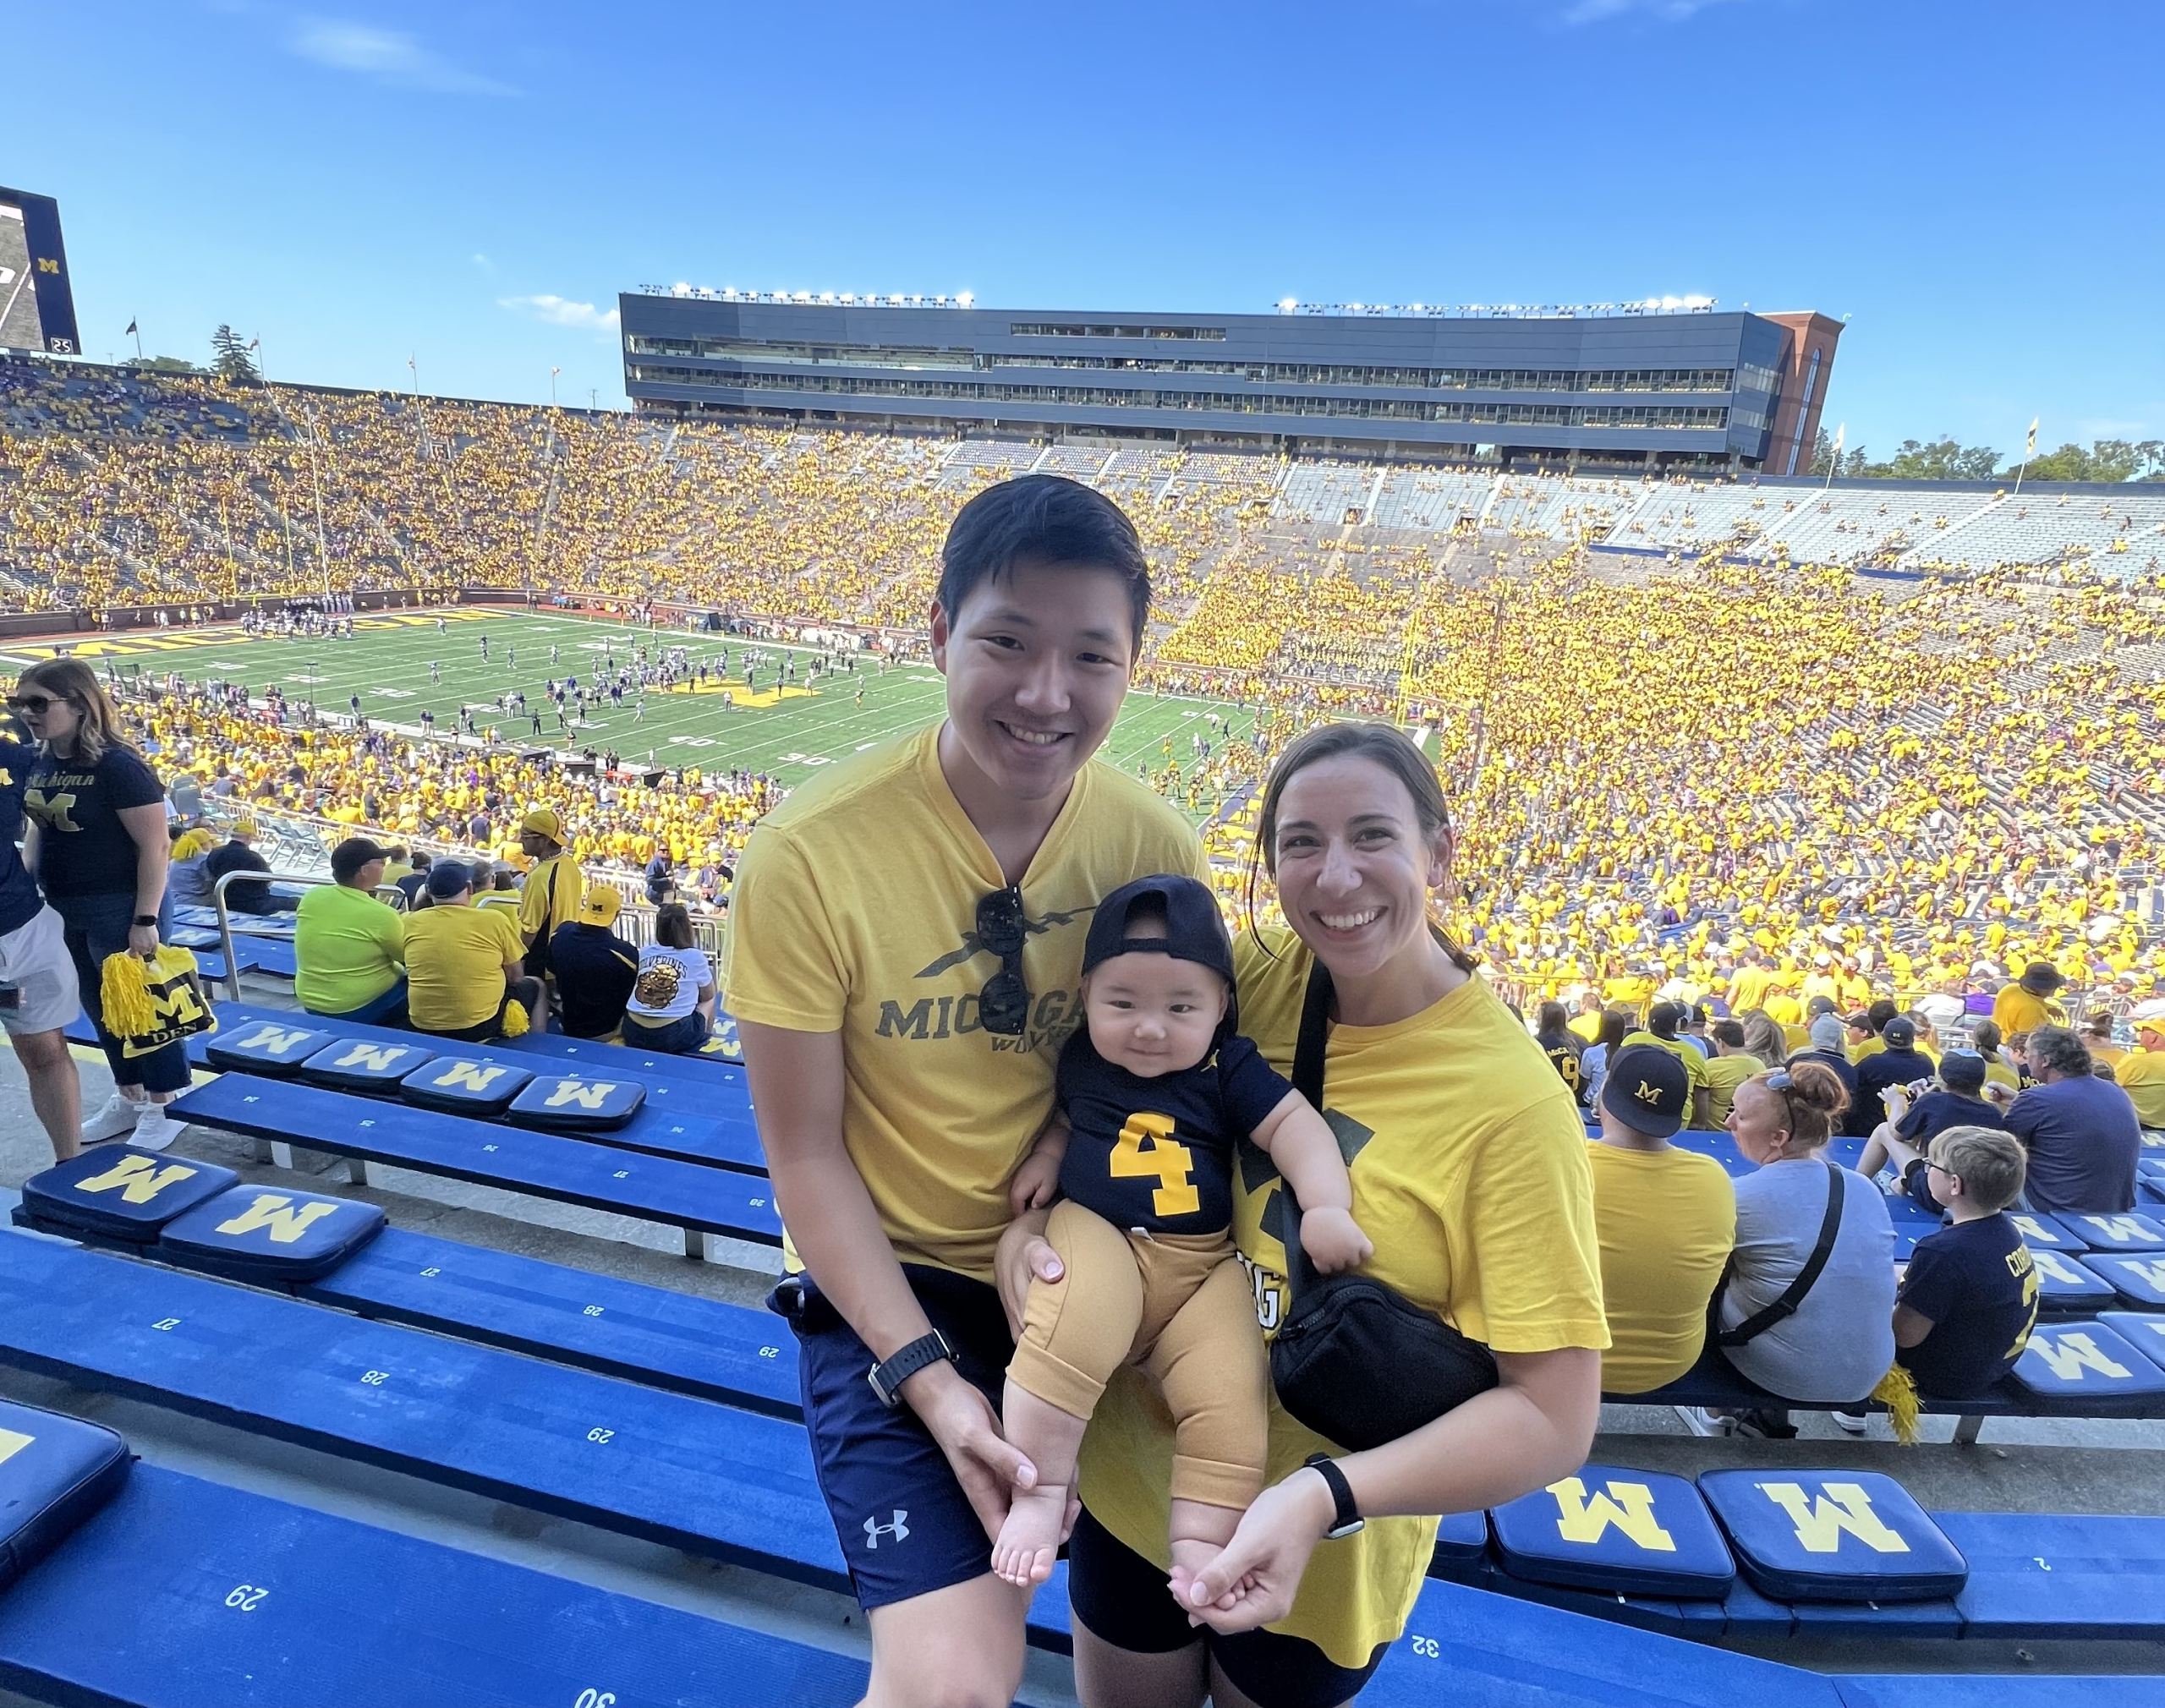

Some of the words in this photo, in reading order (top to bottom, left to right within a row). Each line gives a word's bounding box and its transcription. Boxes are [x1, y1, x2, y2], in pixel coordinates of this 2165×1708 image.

[38, 257, 59, 274] M
[53, 339, 70, 353] 25
[24, 788, 81, 832] M
[592, 903, 603, 913] M
[237, 1026, 312, 1054] M
[333, 1043, 409, 1071] M
[432, 1061, 507, 1092] M
[1562, 1056, 1579, 1092] 9
[543, 1081, 617, 1109] M
[1634, 1080, 1663, 1105] M
[613, 1170, 630, 1179] 27
[1110, 1111, 1200, 1217] 4
[74, 1154, 199, 1204] M
[215, 1194, 339, 1243] M
[420, 1267, 441, 1278] 27
[151, 1317, 181, 1331] 27
[583, 1305, 605, 1317] 28
[759, 1345, 780, 1359] 29
[2025, 1332, 2134, 1380] M
[360, 1370, 390, 1386] 28
[587, 1427, 615, 1444] 29
[1545, 1476, 1677, 1552] M
[1759, 1482, 1911, 1552] M
[2033, 1557, 2052, 1572] 2
[224, 1584, 269, 1612] 29
[1411, 1634, 1439, 1659] 32
